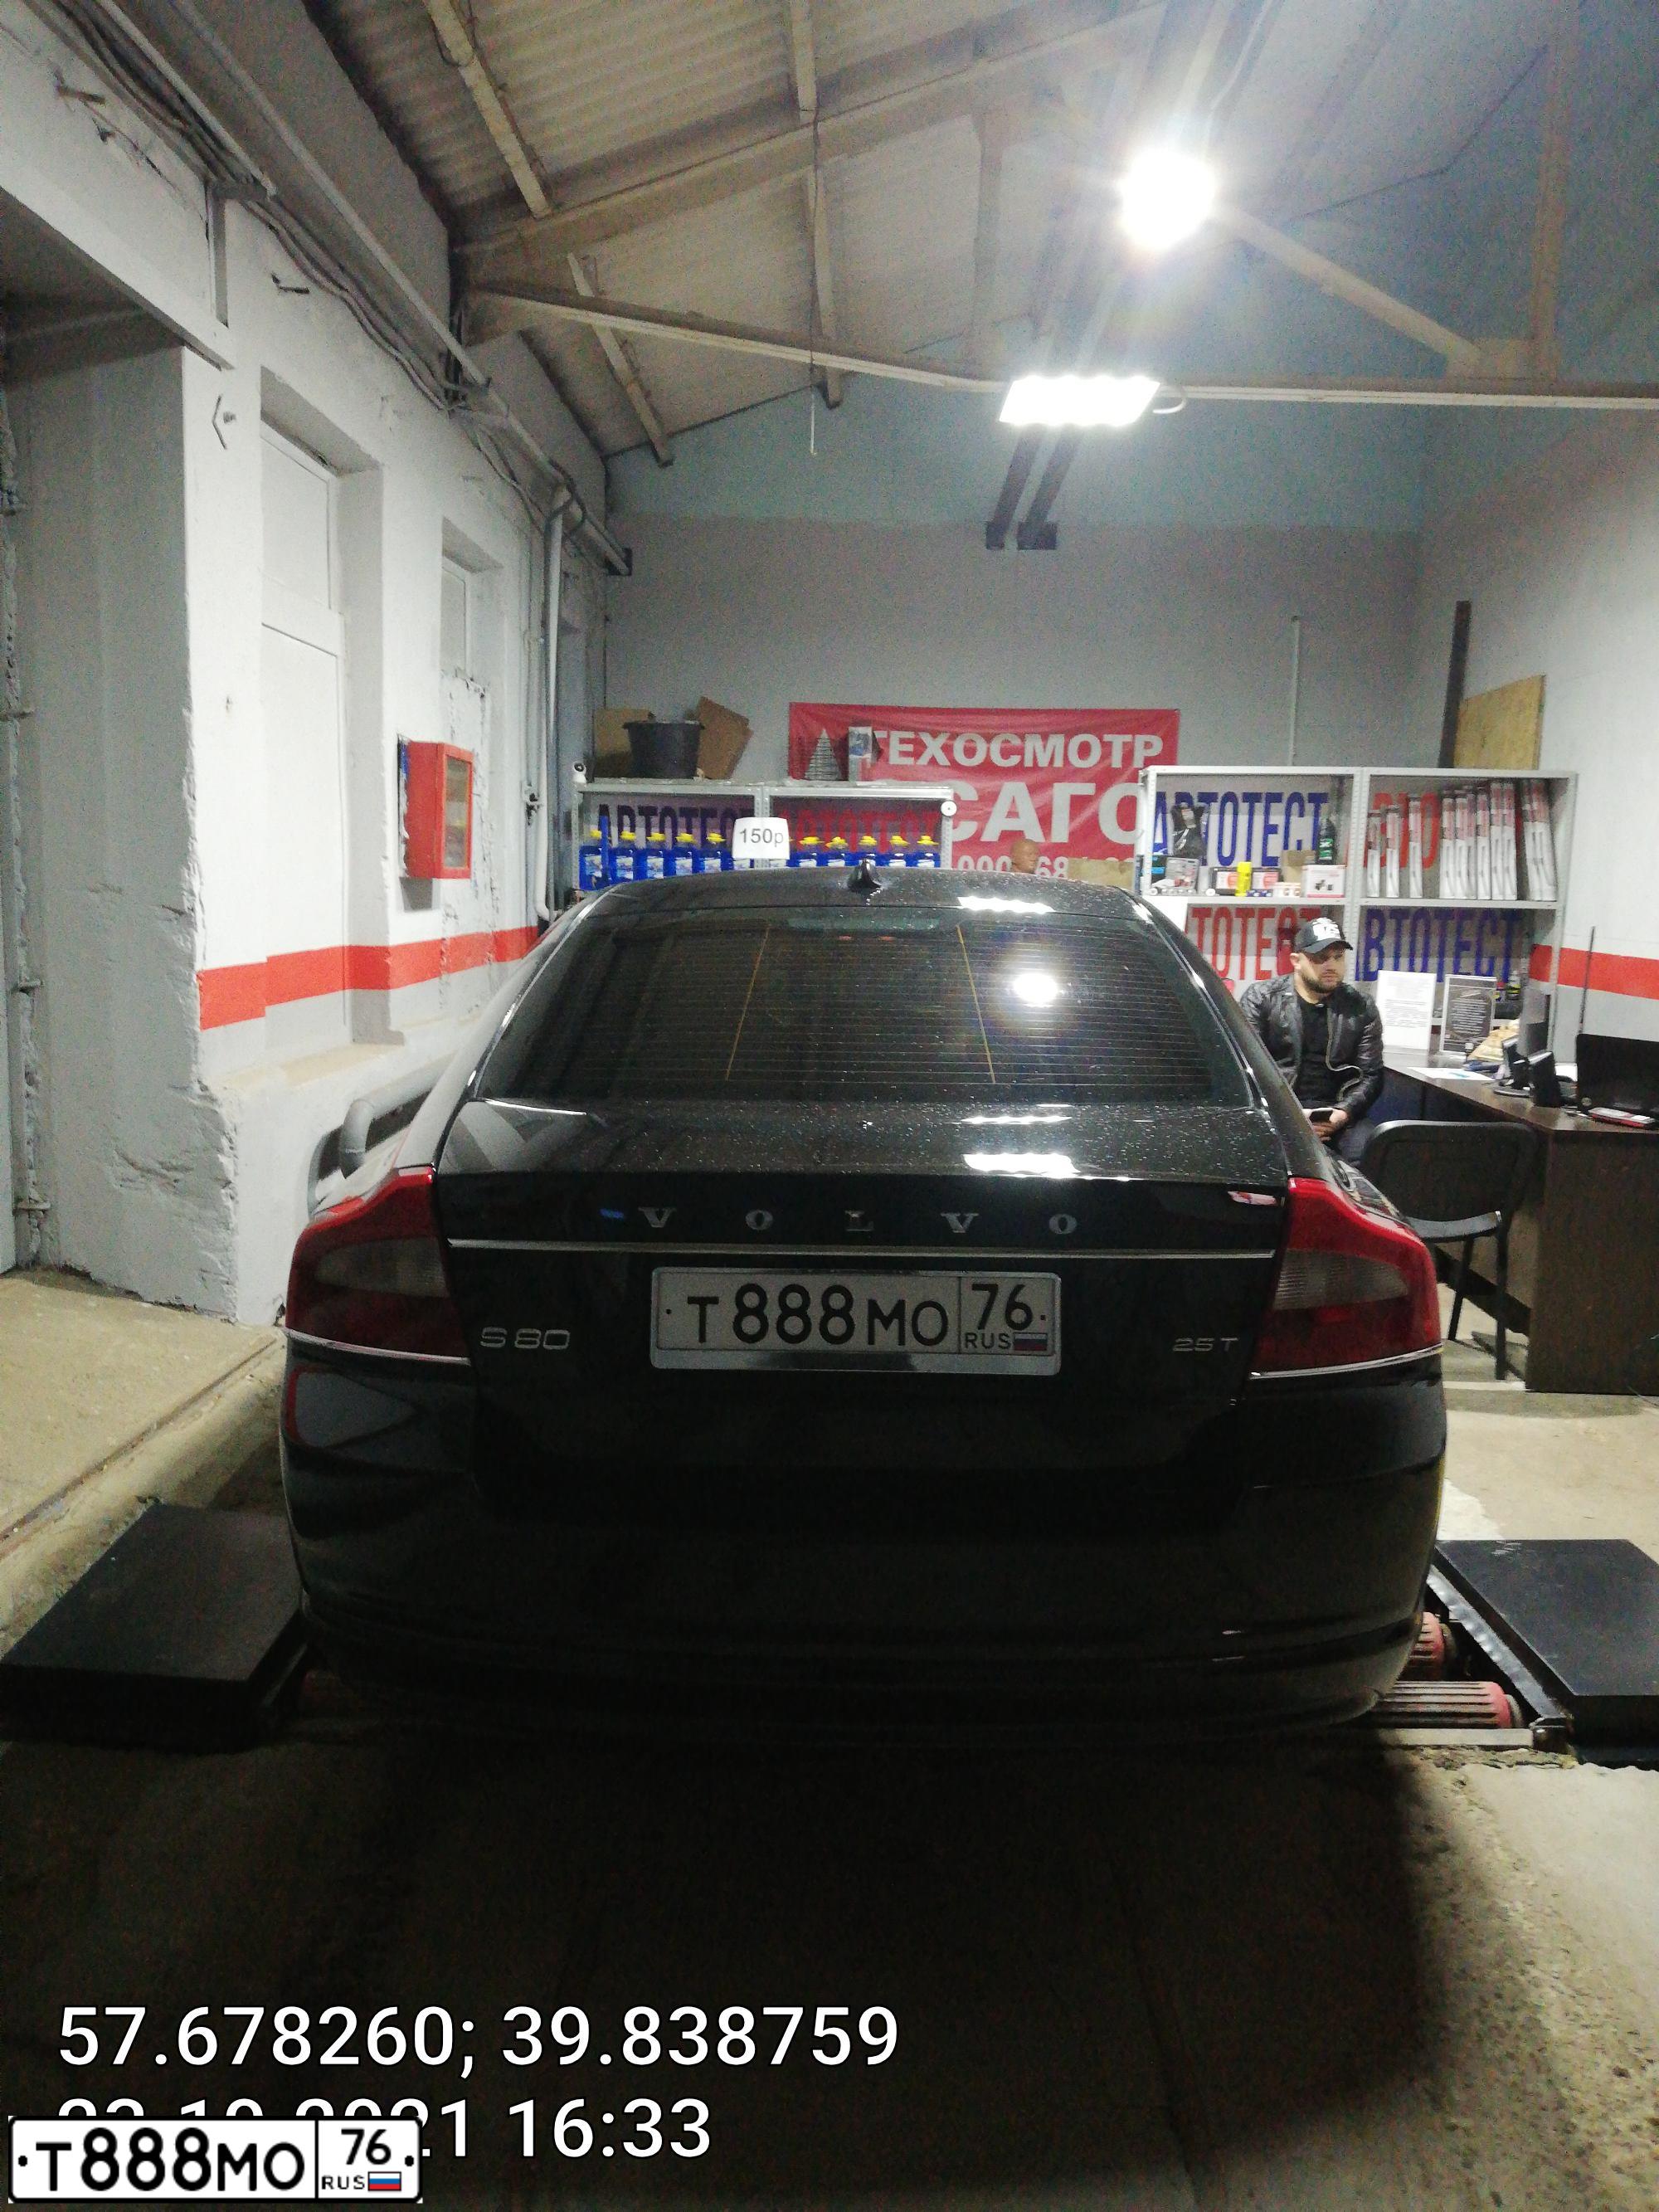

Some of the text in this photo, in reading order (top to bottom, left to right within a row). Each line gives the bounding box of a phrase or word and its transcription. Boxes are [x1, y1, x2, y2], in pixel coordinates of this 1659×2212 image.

[943, 779, 1144, 843] САГО
[739, 828, 784, 847] 150р
[1355, 908, 1523, 982] ВТОТЕСТ
[638, 1206, 1078, 1235] VOLVO
[687, 1283, 1033, 1347] Т888МО 76
[964, 1331, 1010, 1349] RUS
